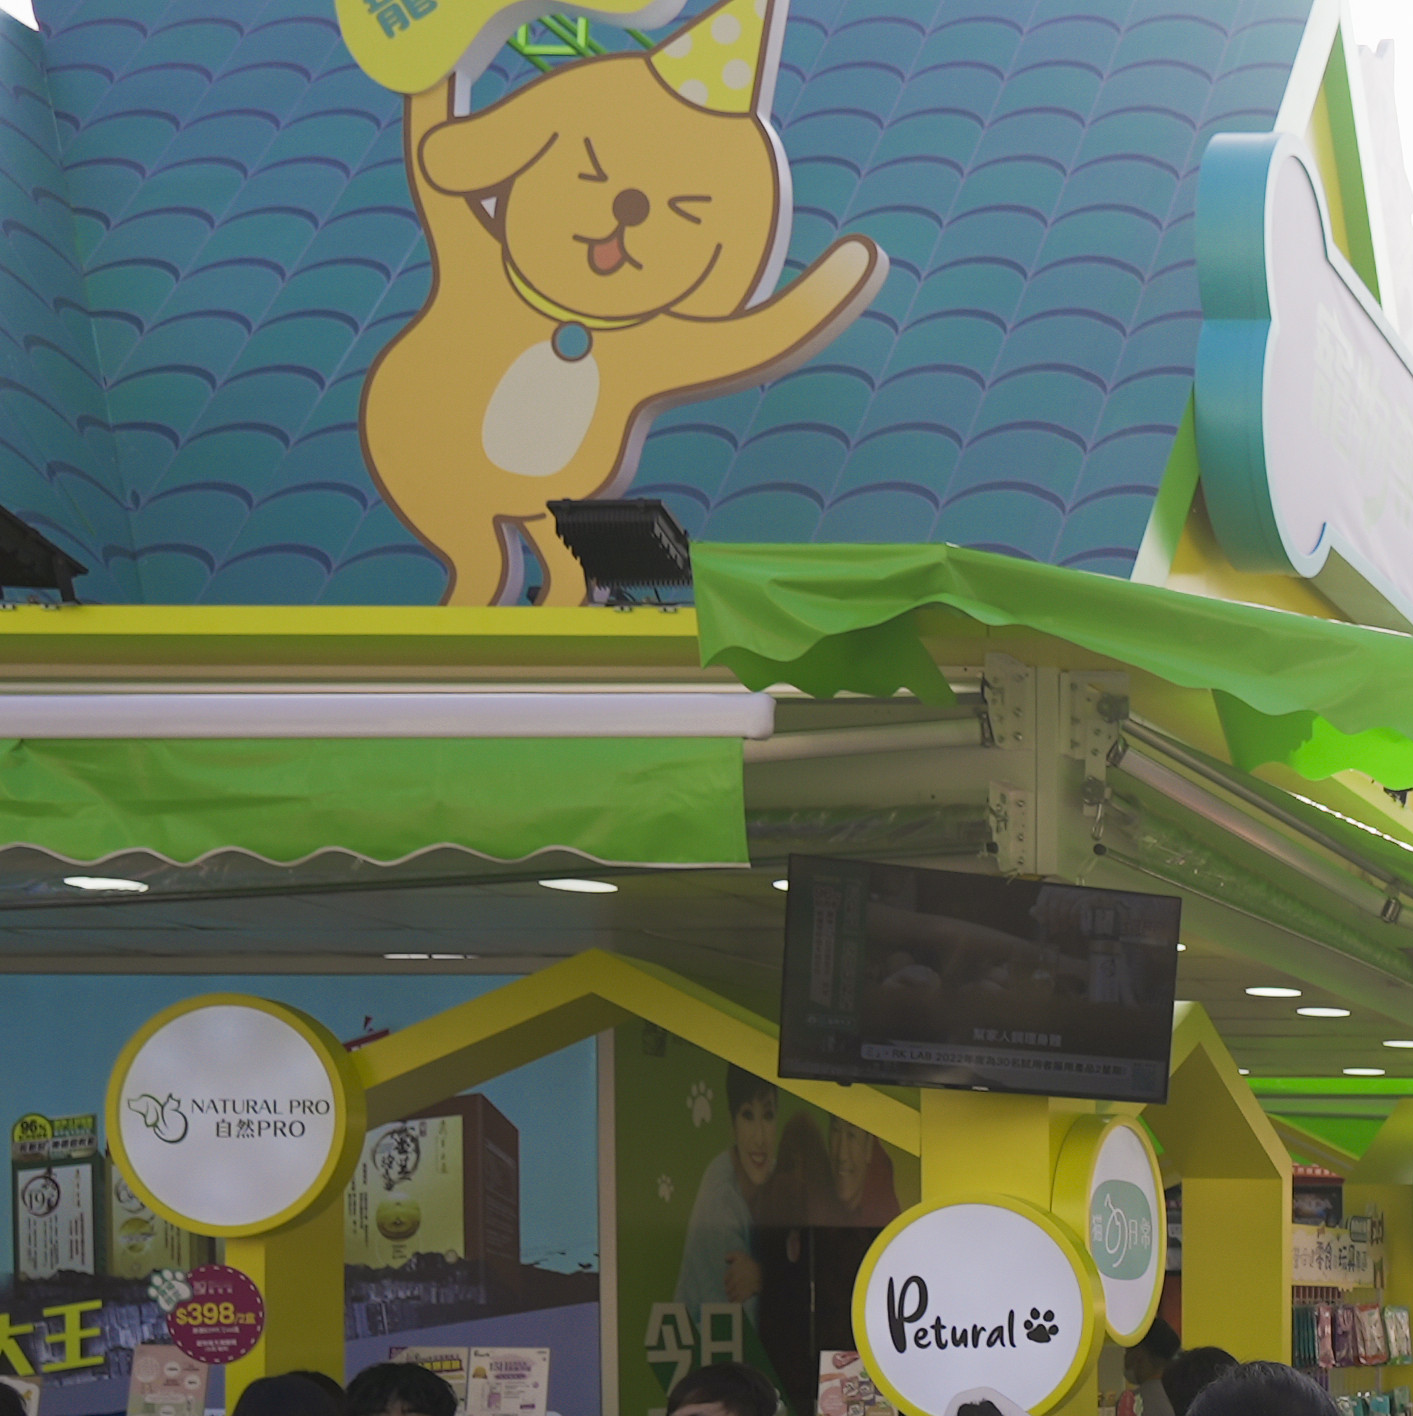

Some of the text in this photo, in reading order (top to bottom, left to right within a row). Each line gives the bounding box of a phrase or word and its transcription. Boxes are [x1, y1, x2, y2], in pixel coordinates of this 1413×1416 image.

[191, 1098, 331, 1115] NATURAL PRO
[214, 1119, 306, 1139] 自然PRO
[886, 1275, 1016, 1353] Petural
